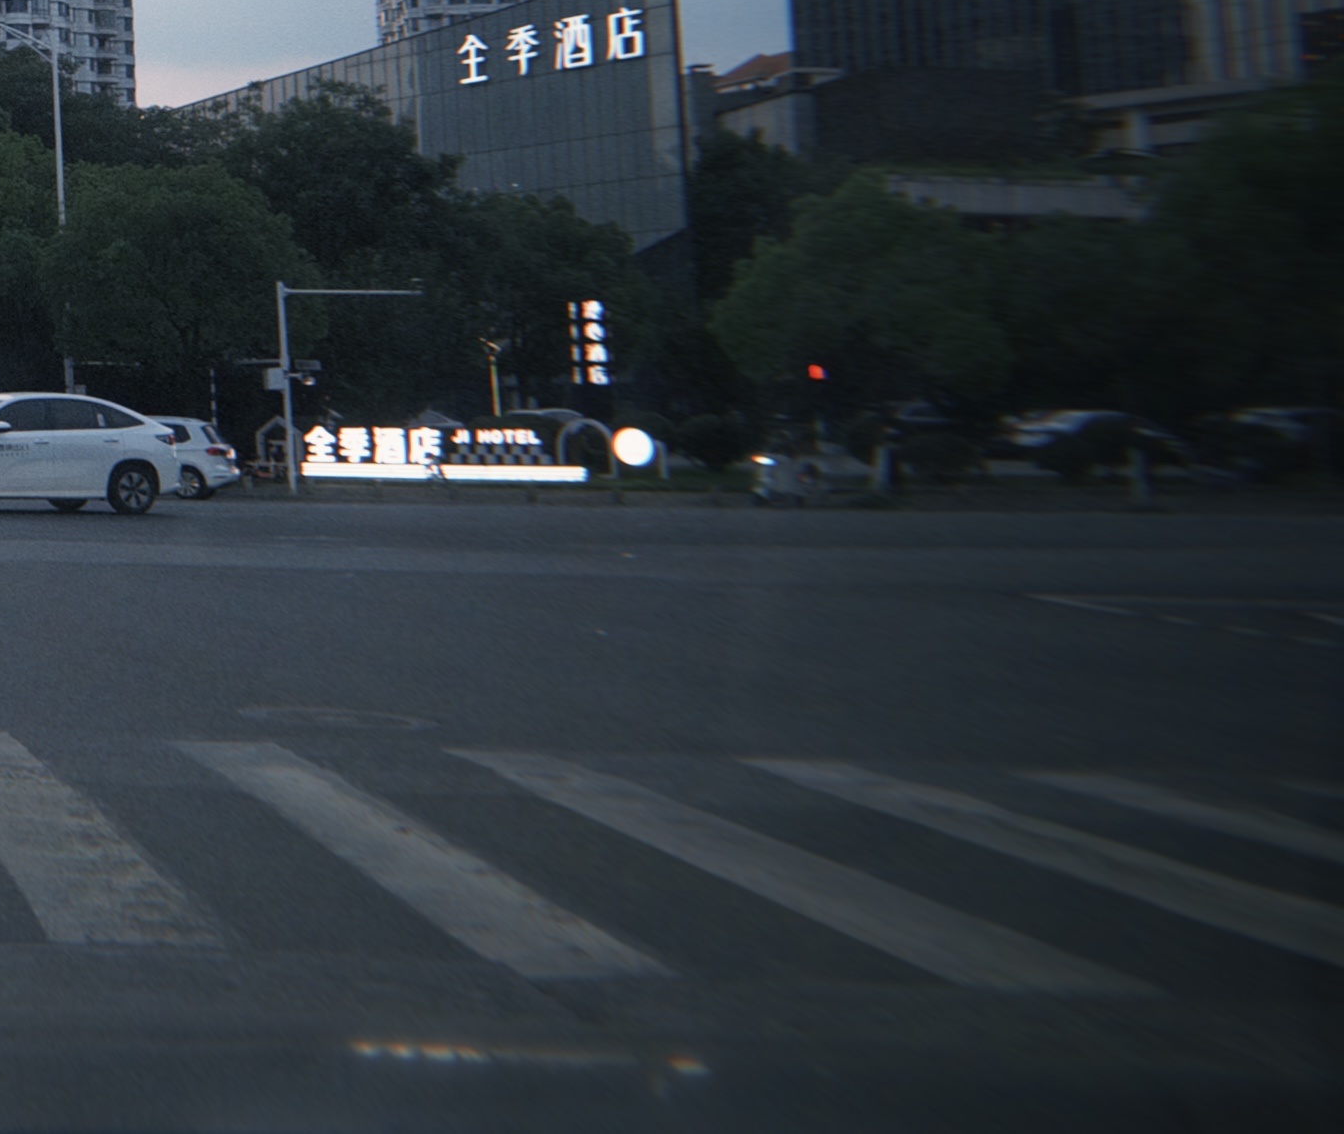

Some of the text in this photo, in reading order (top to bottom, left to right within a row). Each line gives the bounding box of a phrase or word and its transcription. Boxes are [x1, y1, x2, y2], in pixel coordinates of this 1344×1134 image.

[457, 7, 644, 85] 全季酒店
[303, 425, 441, 465] 全季酒店
[451, 428, 541, 445] JI HOTEL
